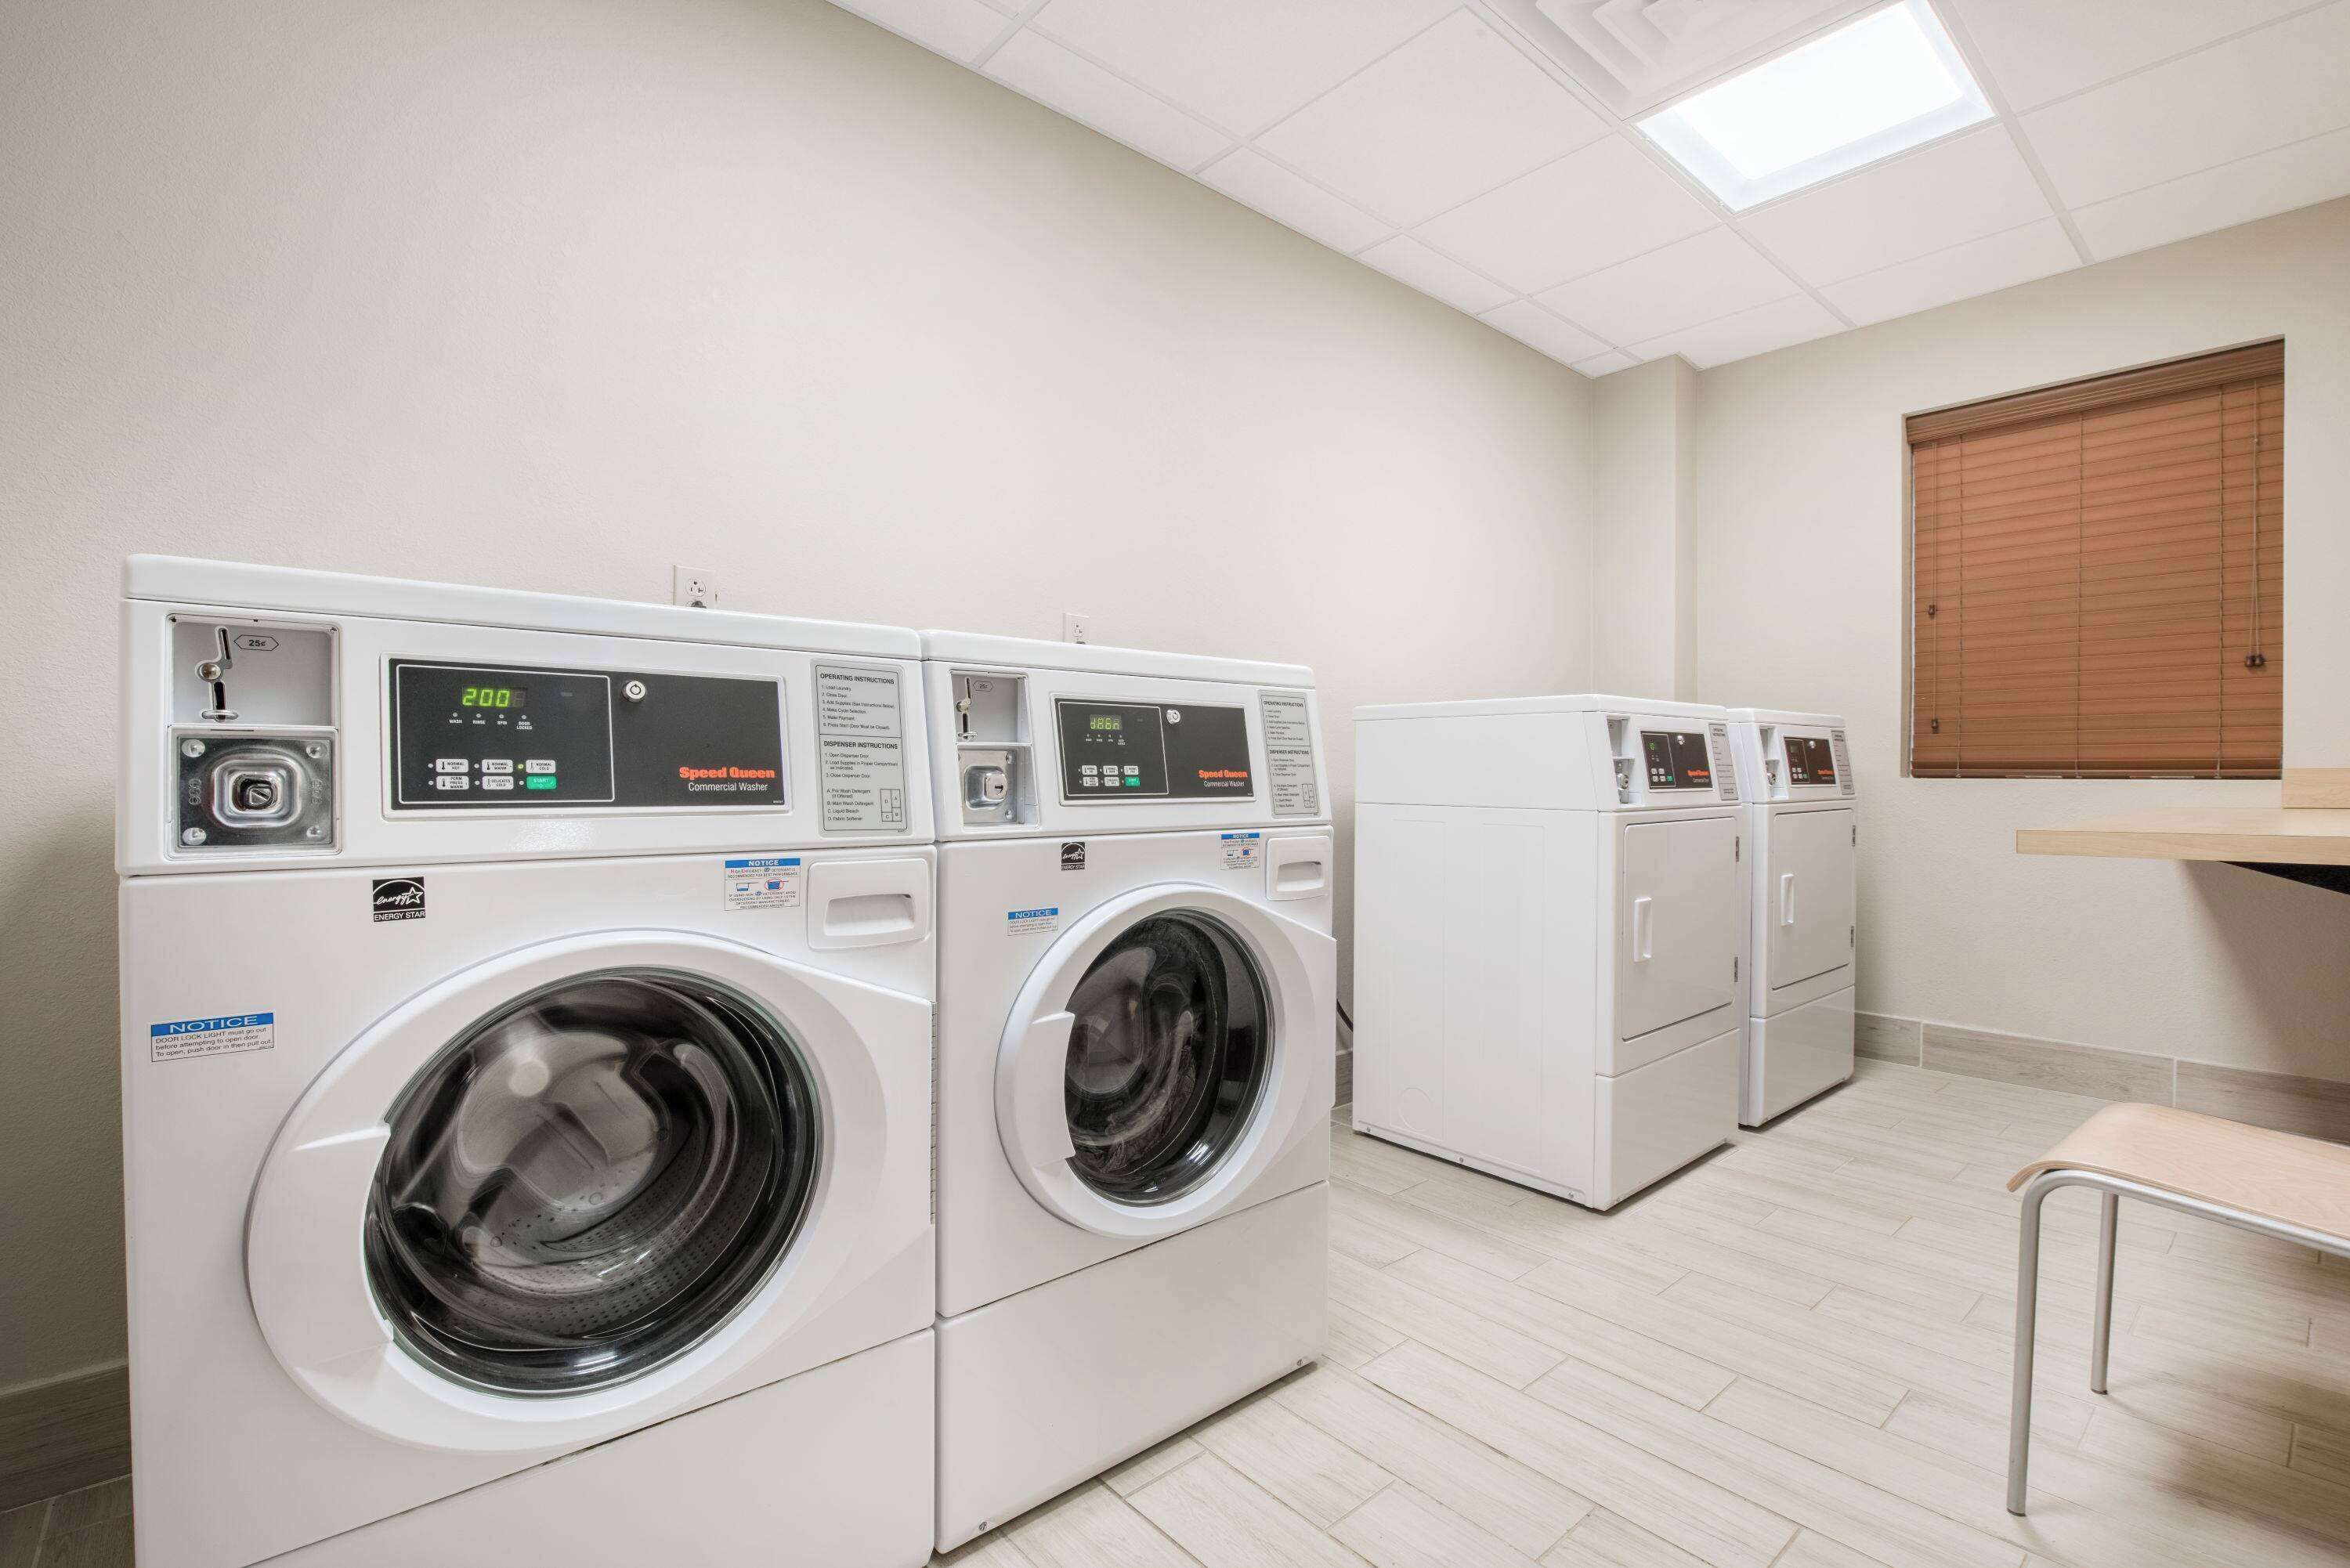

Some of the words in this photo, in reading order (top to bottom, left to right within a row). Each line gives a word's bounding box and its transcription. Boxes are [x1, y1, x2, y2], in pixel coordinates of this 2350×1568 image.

[854, 676, 895, 685] INSTRUCTIONS
[462, 688, 510, 706] 200
[678, 767, 728, 780] Speed
[729, 767, 776, 779] Queen
[1198, 769, 1224, 779] Speed
[1224, 769, 1248, 778] Queen
[688, 782, 737, 791] Commercial
[738, 782, 768, 791] Washer
[376, 895, 407, 905] energy
[374, 912, 404, 921] ENERGY
[1015, 909, 1052, 919] NOTICE
[170, 1016, 258, 1034] NOTICE
[179, 1039, 215, 1048] attempting
